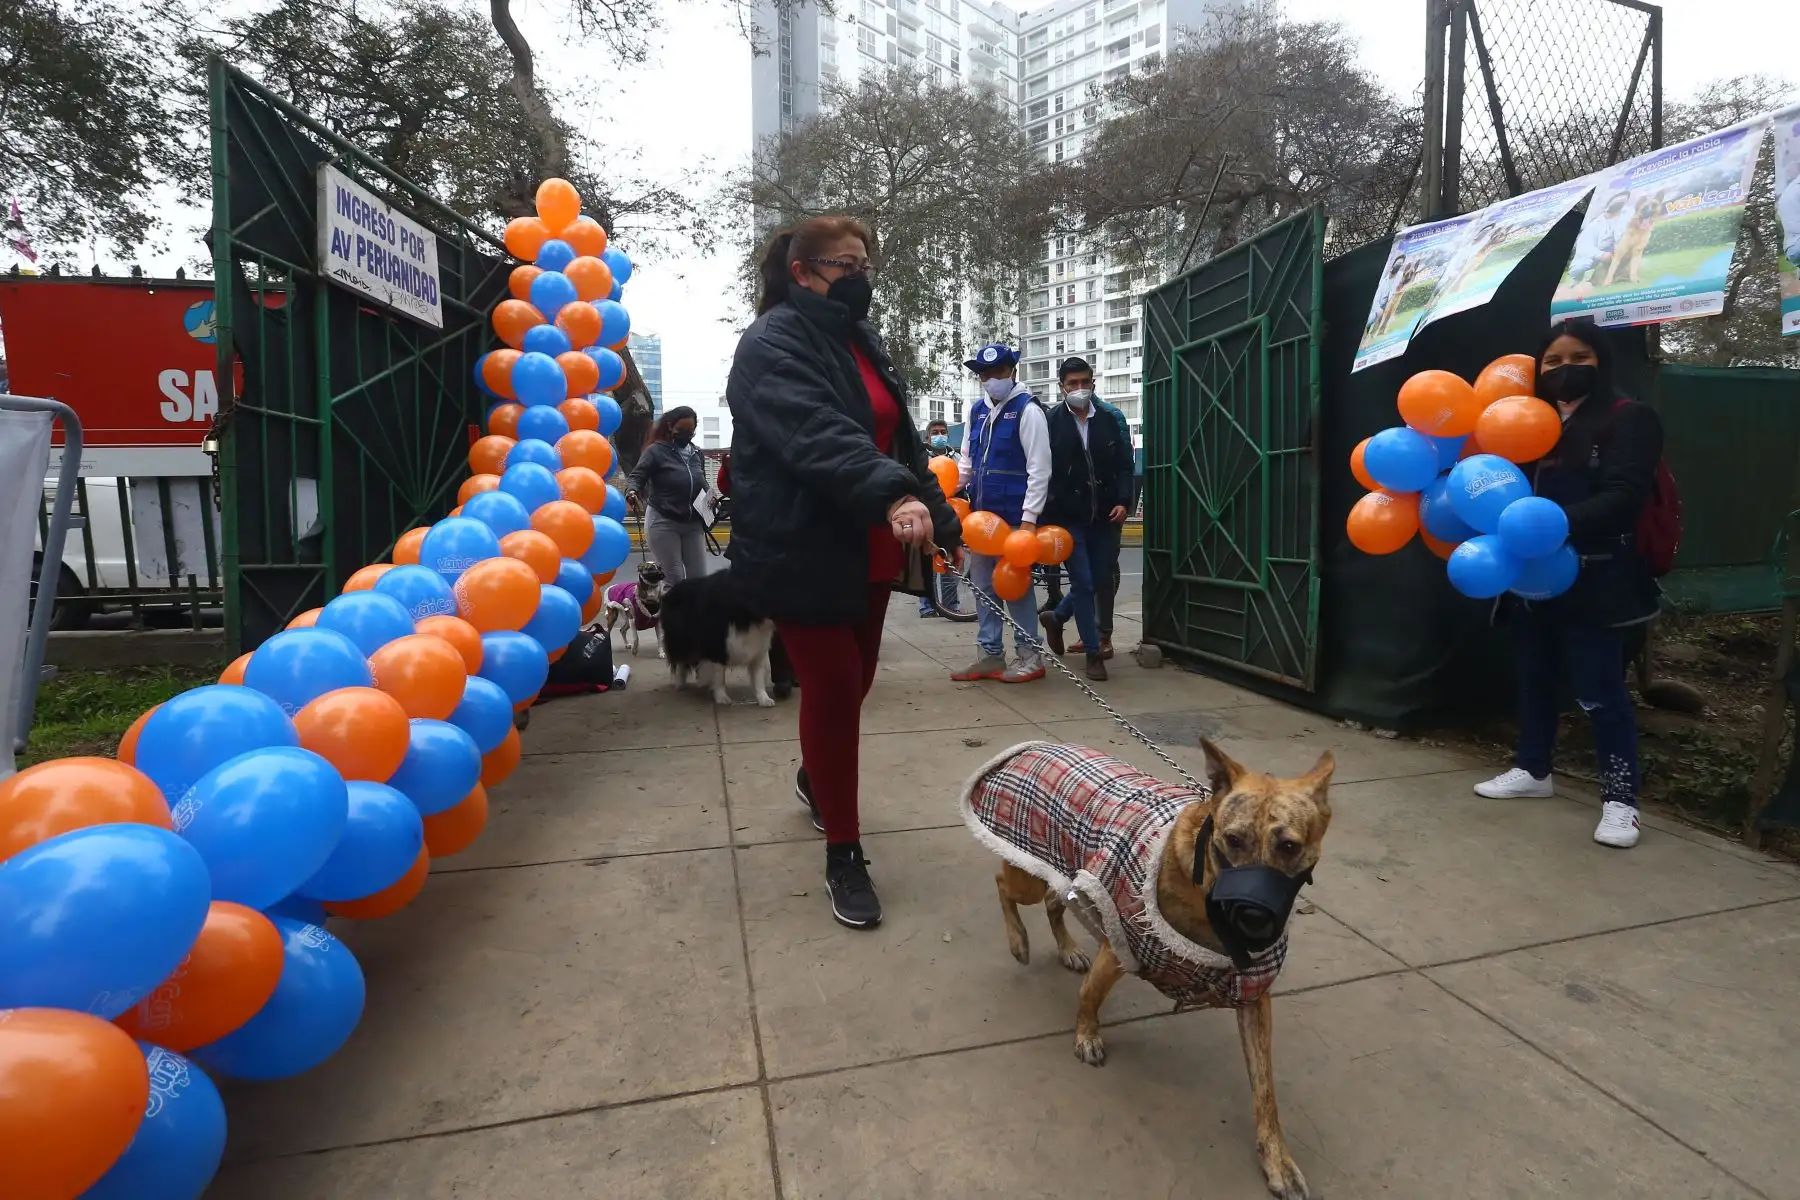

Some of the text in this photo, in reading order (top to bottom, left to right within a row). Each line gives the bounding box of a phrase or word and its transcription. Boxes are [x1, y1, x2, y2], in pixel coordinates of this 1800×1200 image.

[1692, 138, 1721, 154] rabia
[336, 185, 426, 264] INGRESO POR
[331, 226, 352, 262] AV
[356, 233, 438, 306] PERUANIDAD
